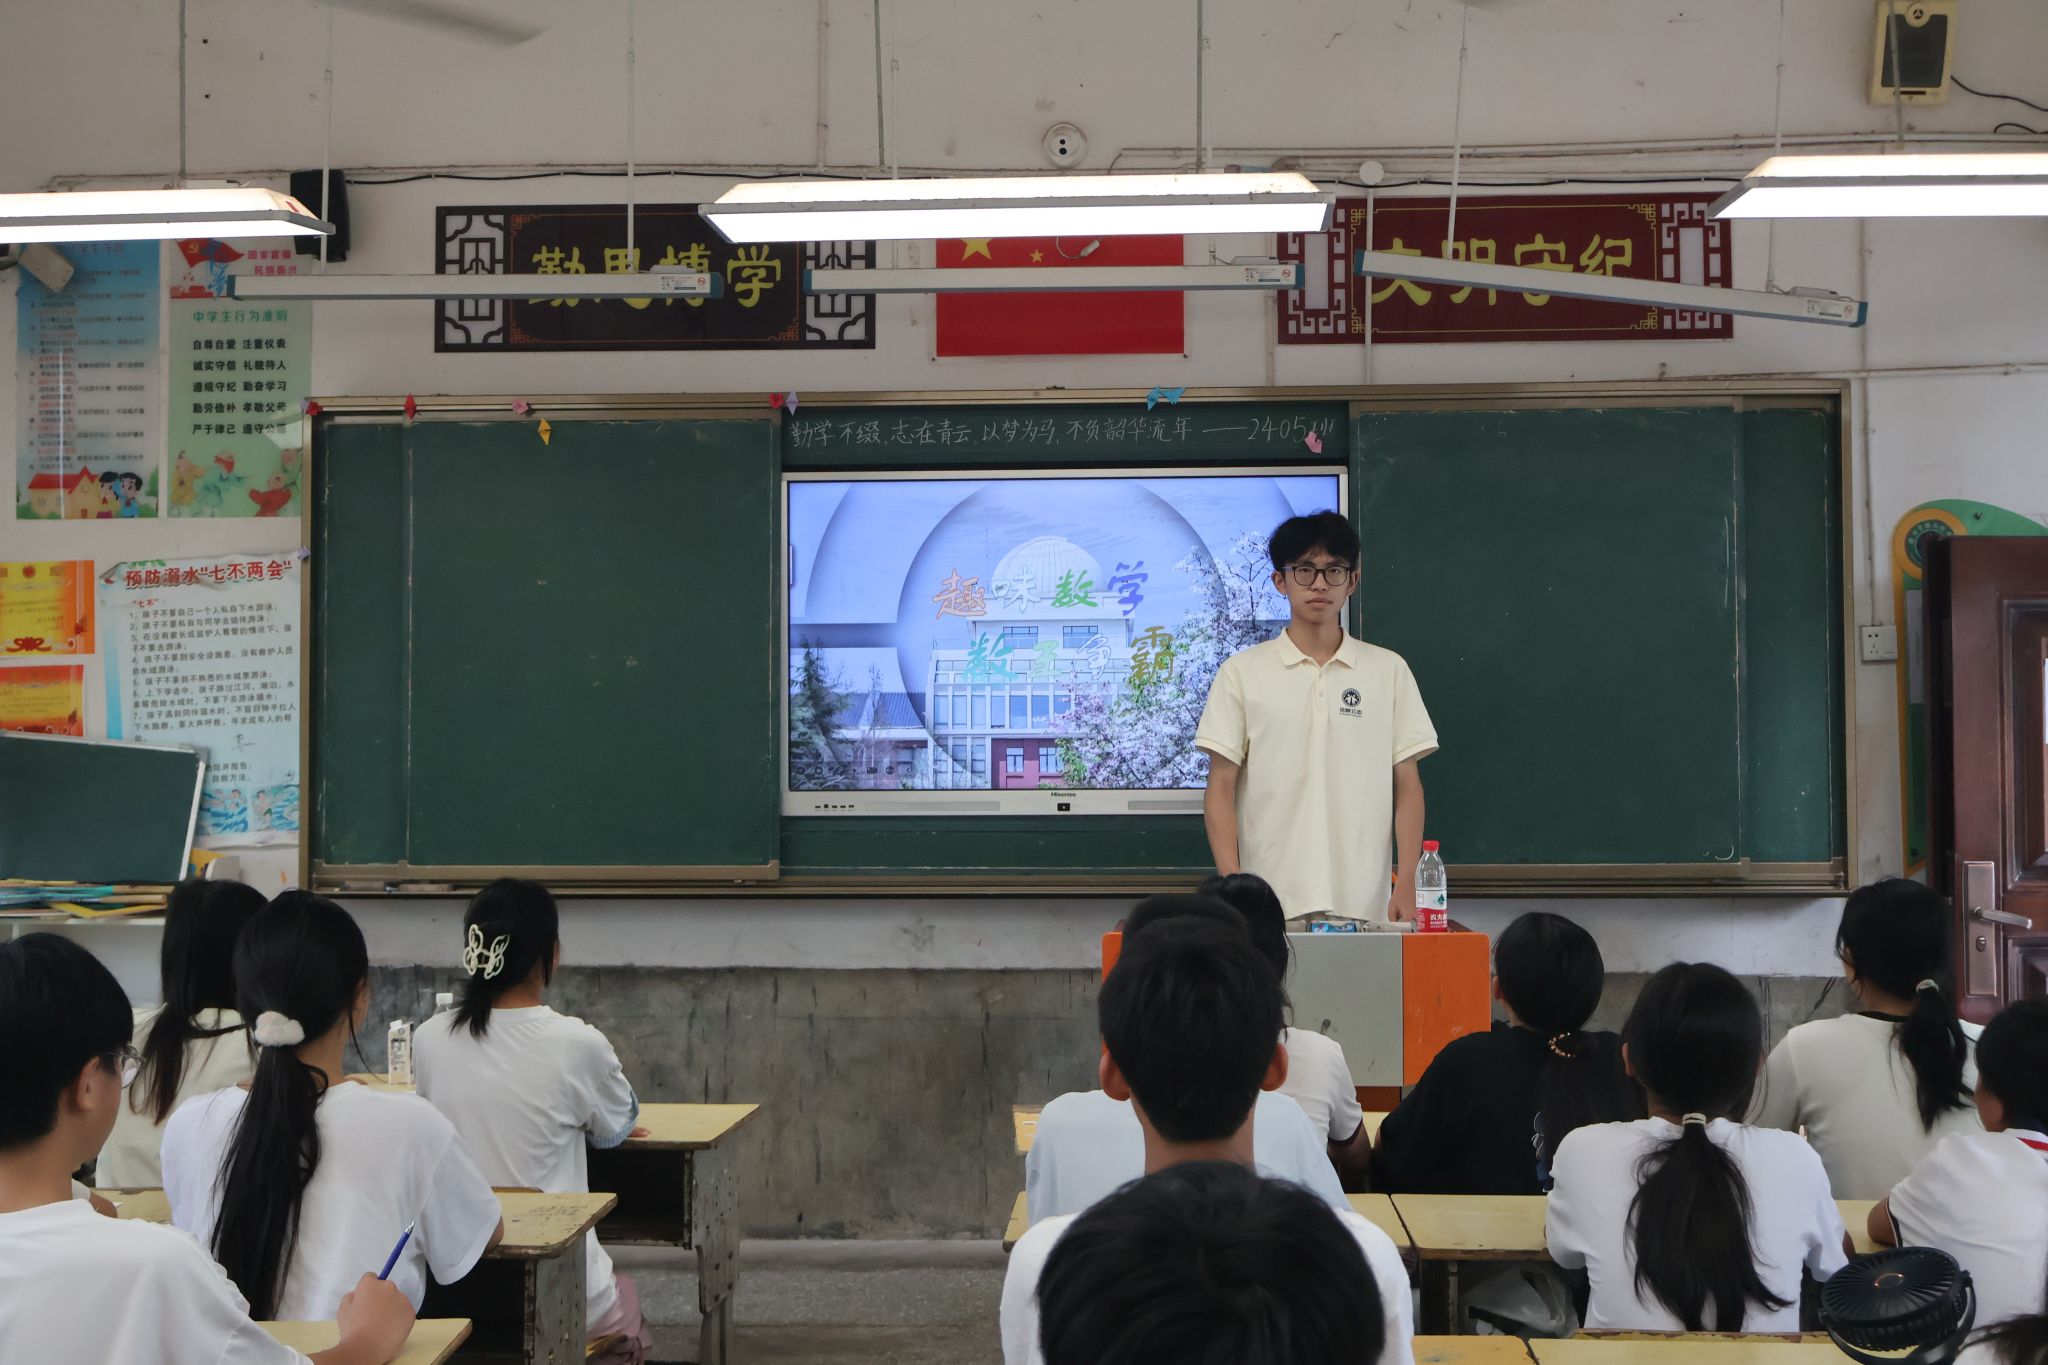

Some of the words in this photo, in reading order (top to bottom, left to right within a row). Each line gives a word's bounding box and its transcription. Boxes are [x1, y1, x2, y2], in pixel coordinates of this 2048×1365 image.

[193, 310, 287, 322] 中学生行为准则
[193, 340, 236, 350] 自尊自爱
[243, 339, 286, 349] 注重仪表
[193, 361, 236, 371] 诚实守信
[244, 360, 287, 370] 礼貌待人
[193, 382, 236, 392] 遵规守纪
[243, 381, 286, 391] 勤奋学习
[192, 424, 236, 434] 严于律己
[933, 560, 1149, 620] 趣味数学
[963, 625, 1175, 682] 数王争霸
